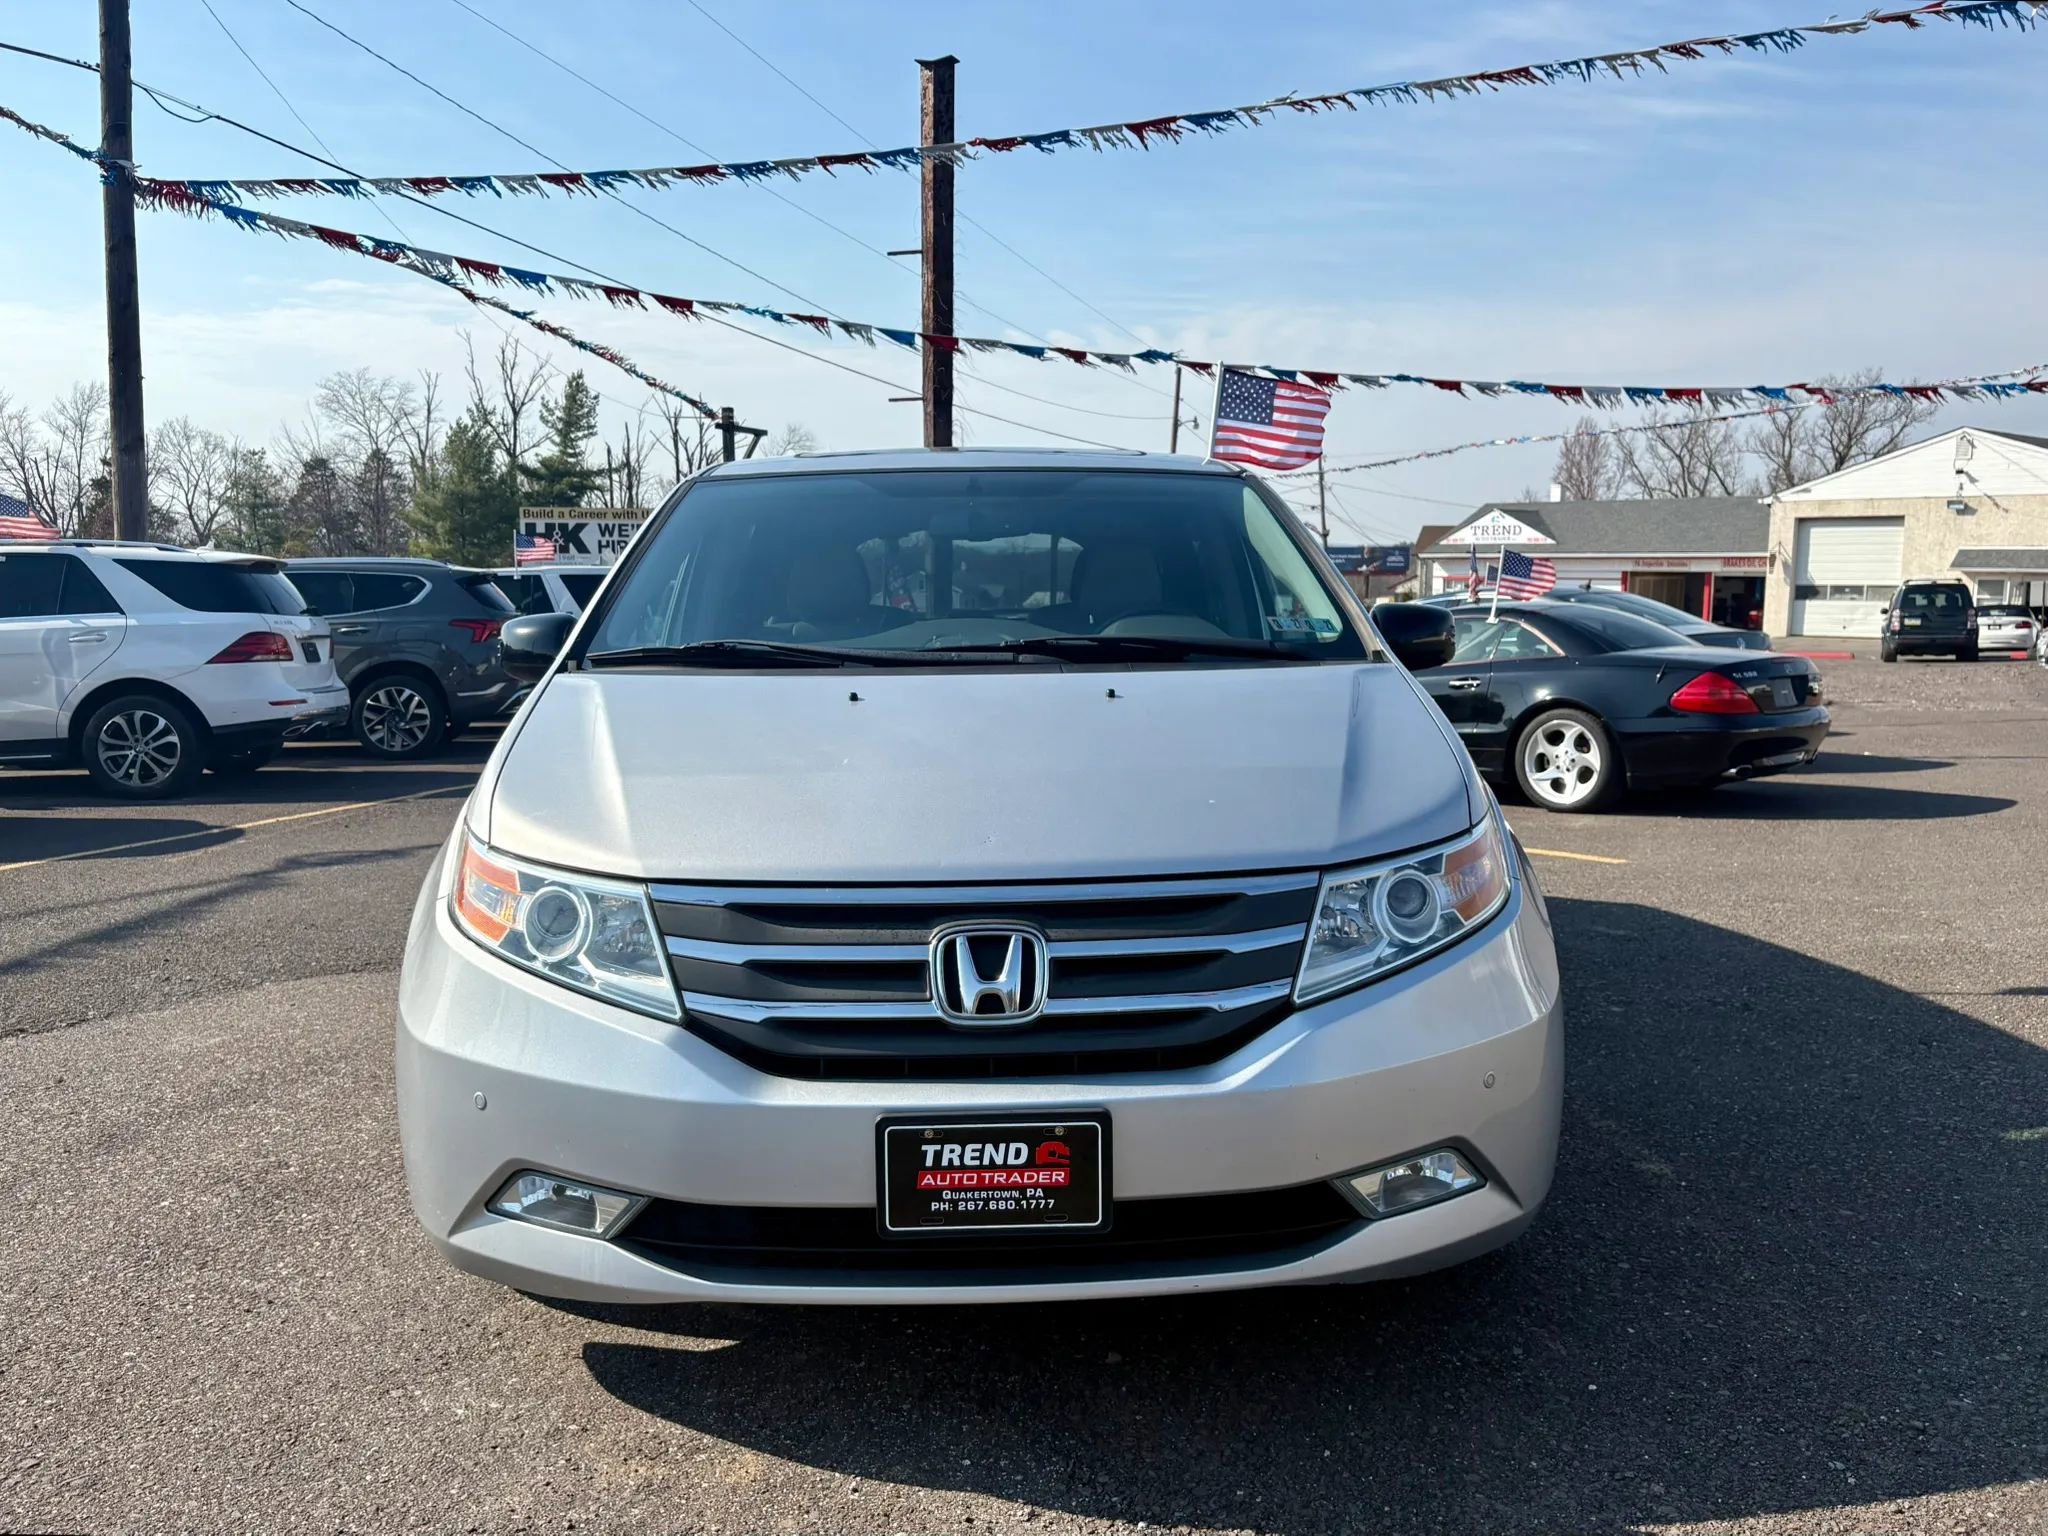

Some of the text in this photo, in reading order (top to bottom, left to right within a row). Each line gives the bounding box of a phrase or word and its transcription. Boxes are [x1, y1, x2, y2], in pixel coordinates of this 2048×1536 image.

[523, 509, 554, 519] Build
[558, 511, 565, 519] a
[568, 509, 607, 519] Career
[611, 509, 638, 519] with
[598, 523, 641, 538] WE'
[1470, 525, 1523, 536] TREND
[921, 1142, 1029, 1167] TREND
[1027, 1188, 1044, 1198] PA
[931, 1199, 1055, 1212] PH: 267.680.1777
